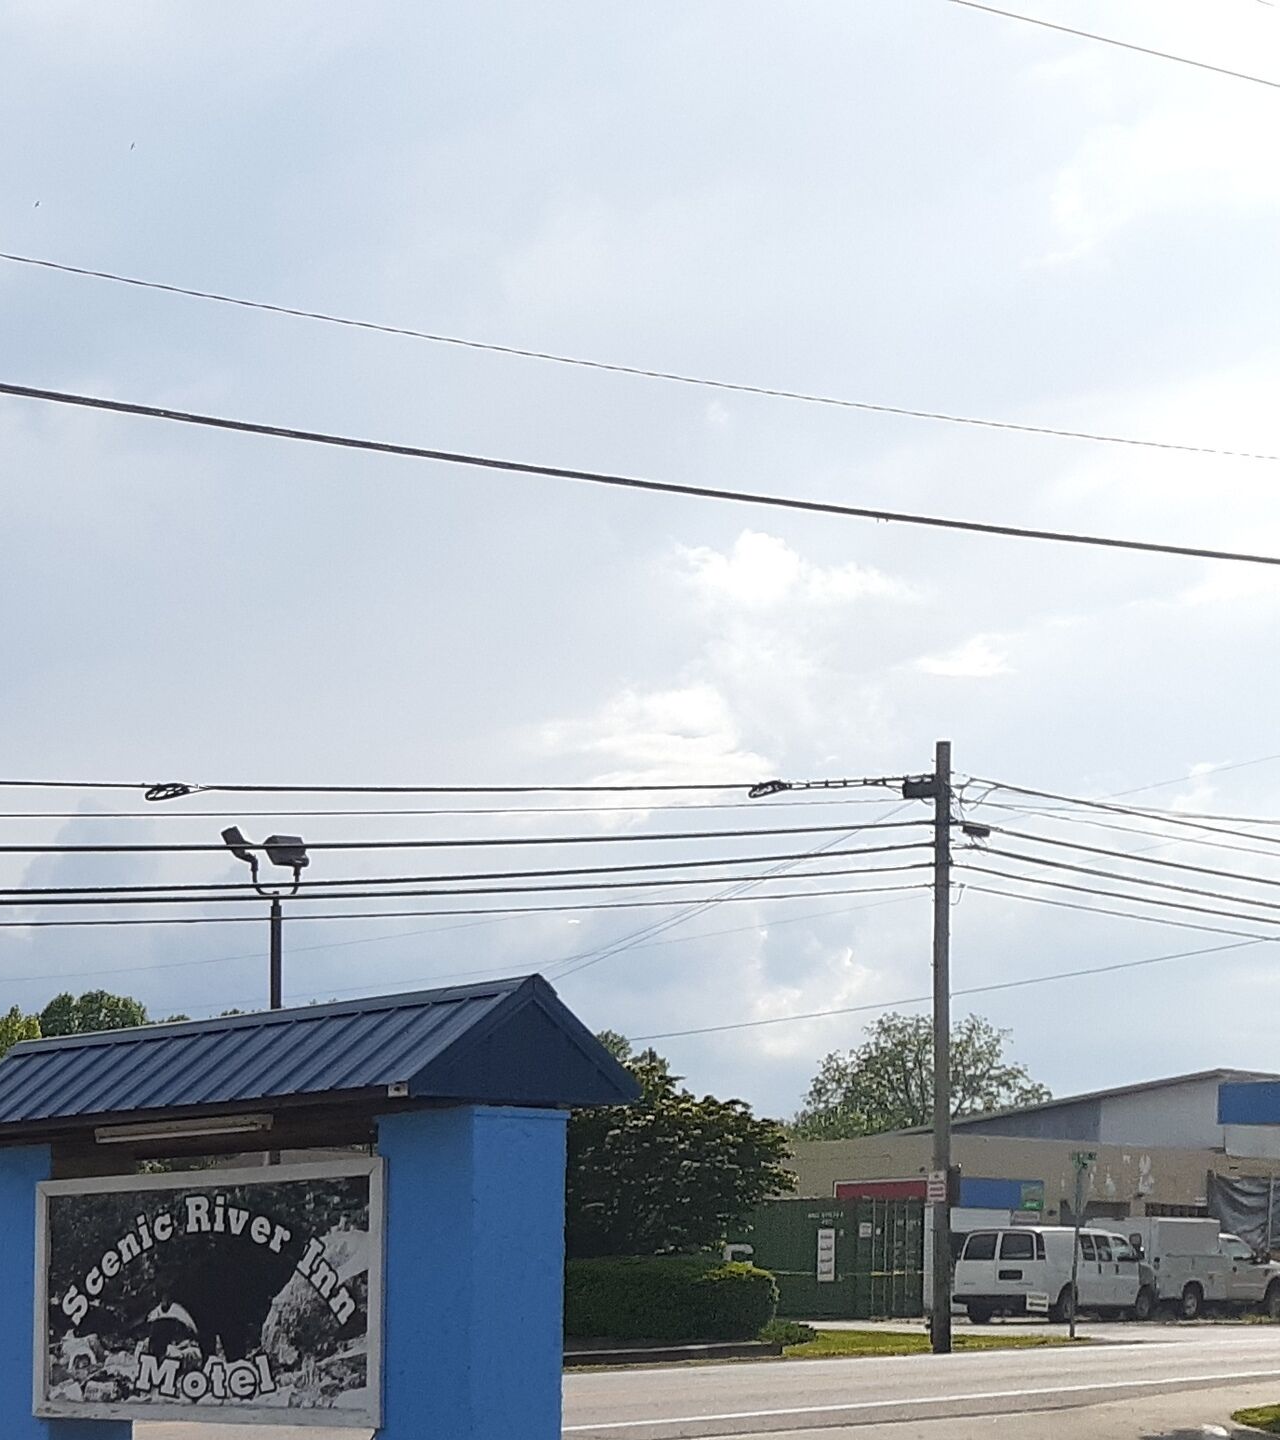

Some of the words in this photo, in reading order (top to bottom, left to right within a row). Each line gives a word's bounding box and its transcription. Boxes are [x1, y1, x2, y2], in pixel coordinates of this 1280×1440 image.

[62, 1213, 174, 1326] Scenic
[185, 1195, 291, 1253] River
[296, 1237, 356, 1326] Inn
[136, 1353, 276, 1399] Motel
